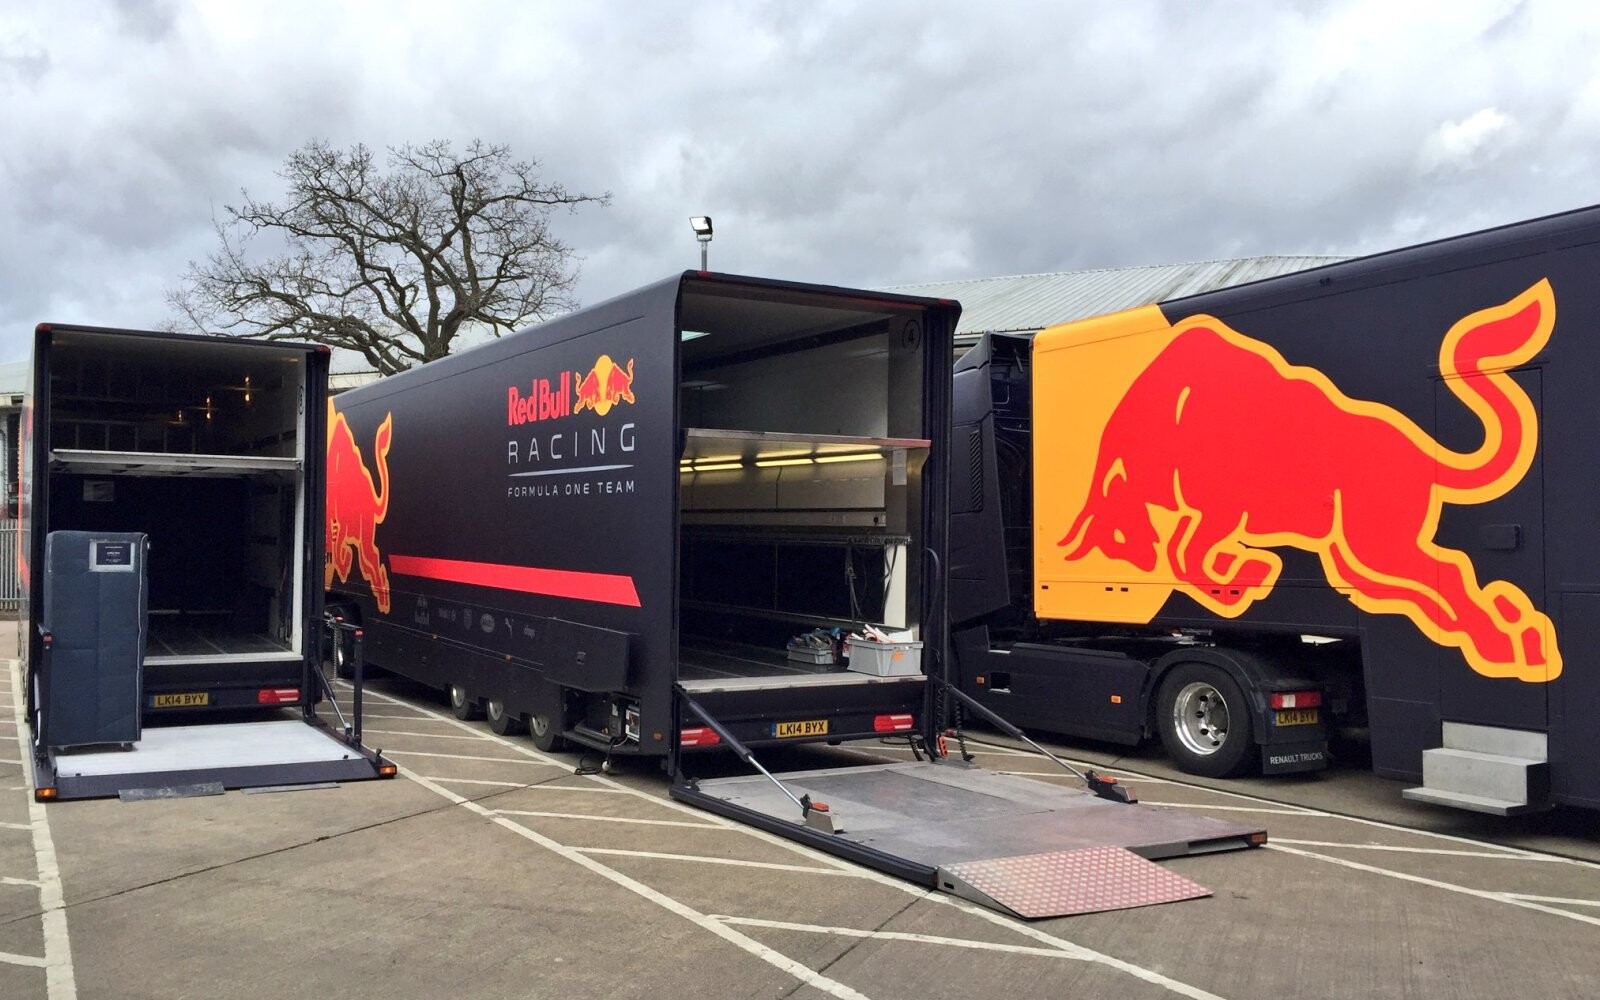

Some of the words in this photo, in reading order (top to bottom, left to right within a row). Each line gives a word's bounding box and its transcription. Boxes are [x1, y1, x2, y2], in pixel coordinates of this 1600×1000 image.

[508, 379, 537, 426] Red
[539, 371, 571, 420] Bull
[508, 423, 635, 465] RACING
[507, 484, 559, 498] FORMULA
[565, 482, 590, 496] ONE
[597, 480, 635, 493] TEAM
[157, 696, 181, 706] LK14
[779, 723, 802, 735] LK14
[805, 721, 824, 733] BYX
[1270, 754, 1299, 765] RENAULT
[1300, 752, 1324, 762] TRUCKS
